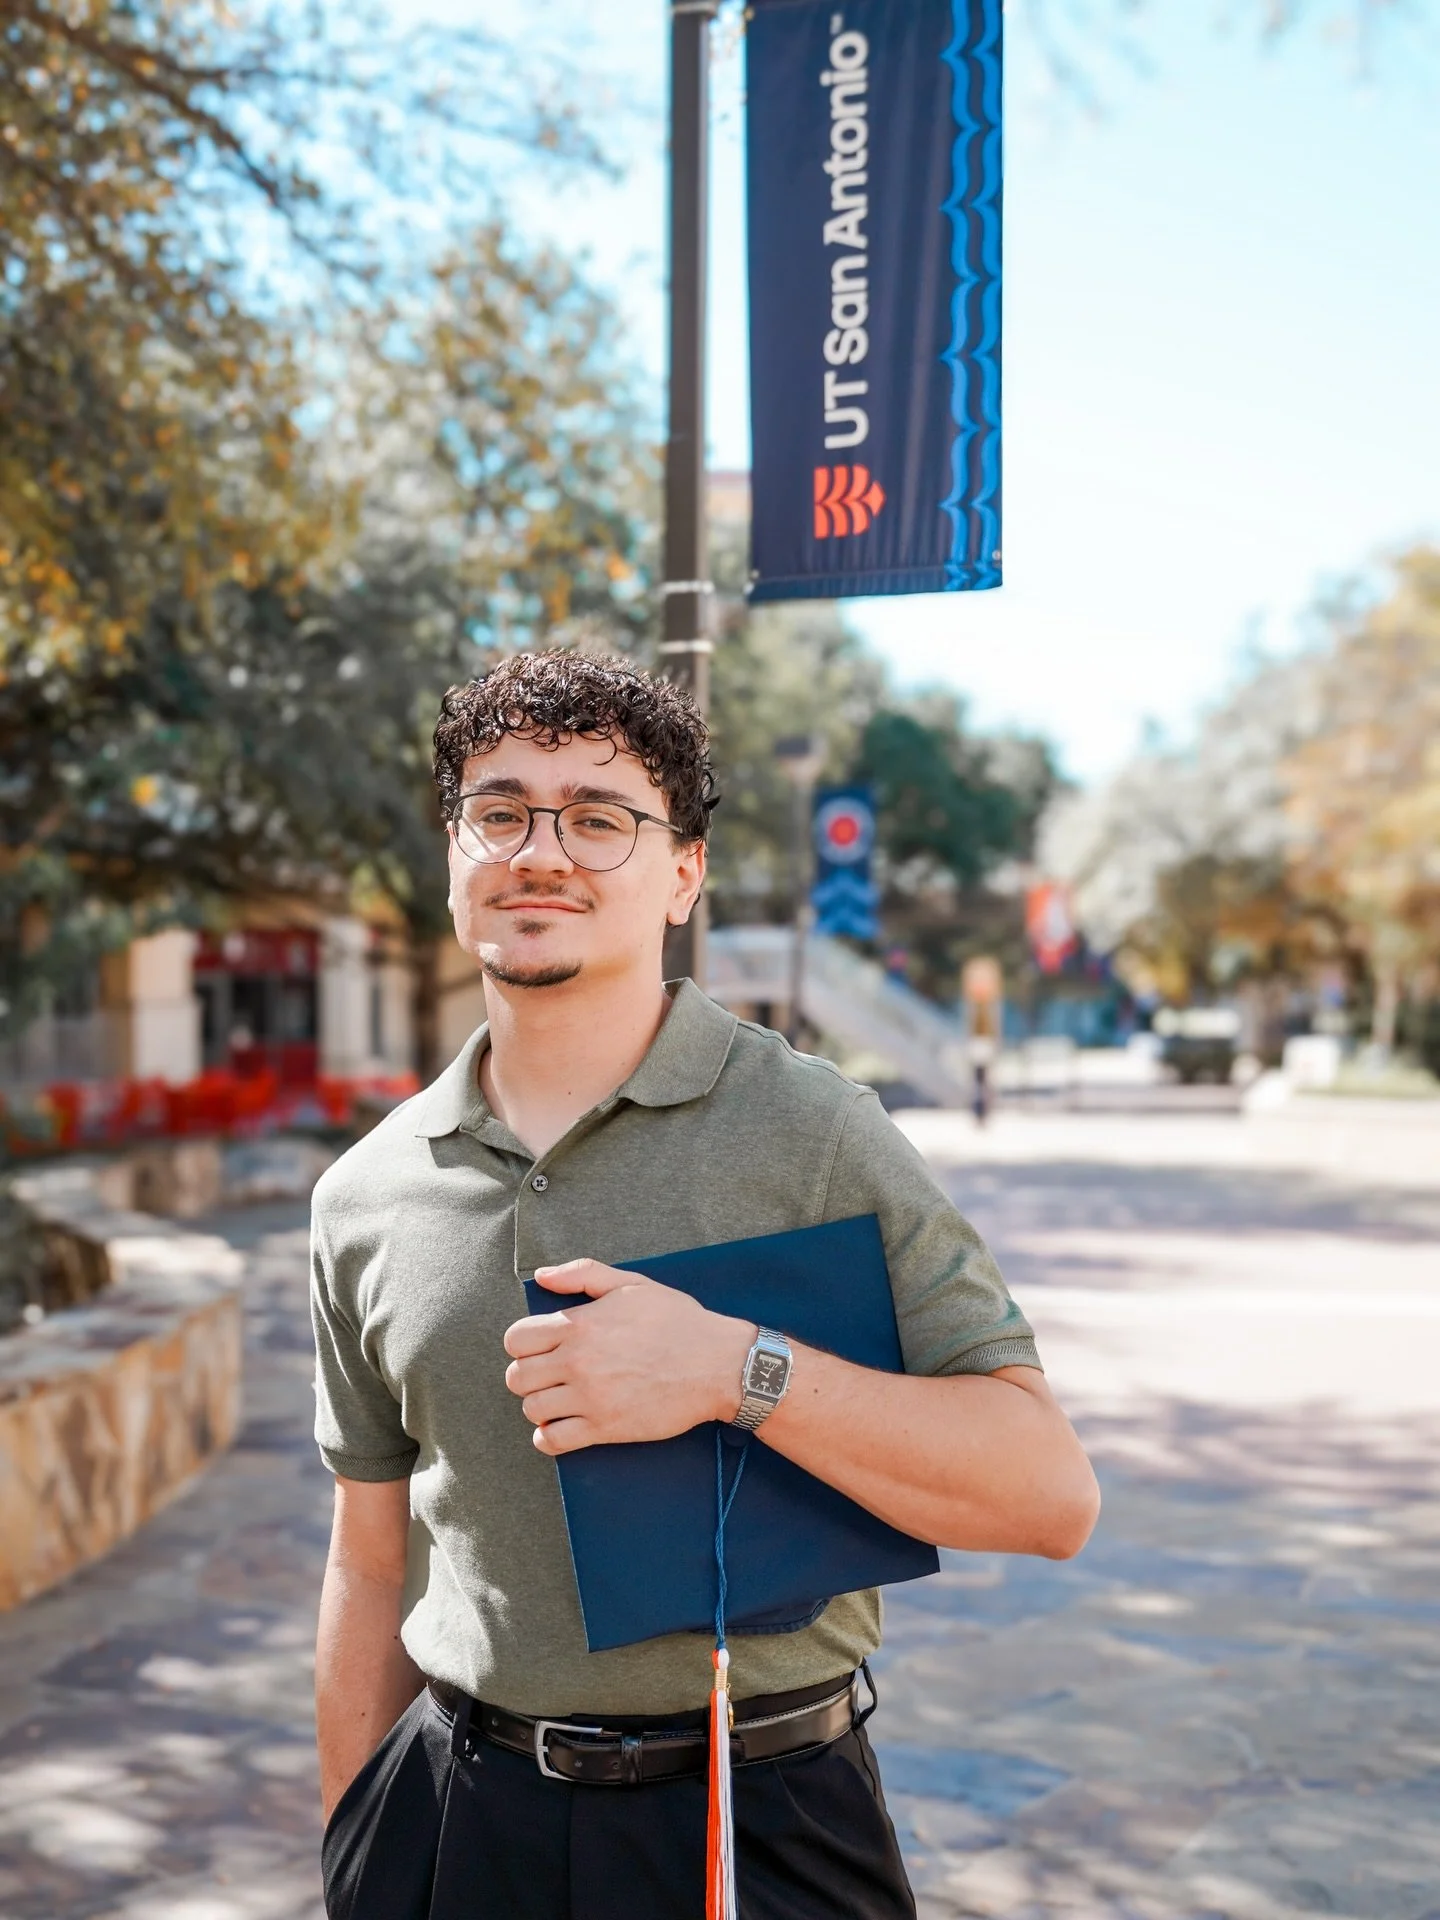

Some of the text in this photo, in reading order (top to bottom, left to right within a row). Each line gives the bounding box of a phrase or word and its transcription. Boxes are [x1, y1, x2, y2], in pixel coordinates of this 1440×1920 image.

[820, 32, 869, 450] UT San Antonio
